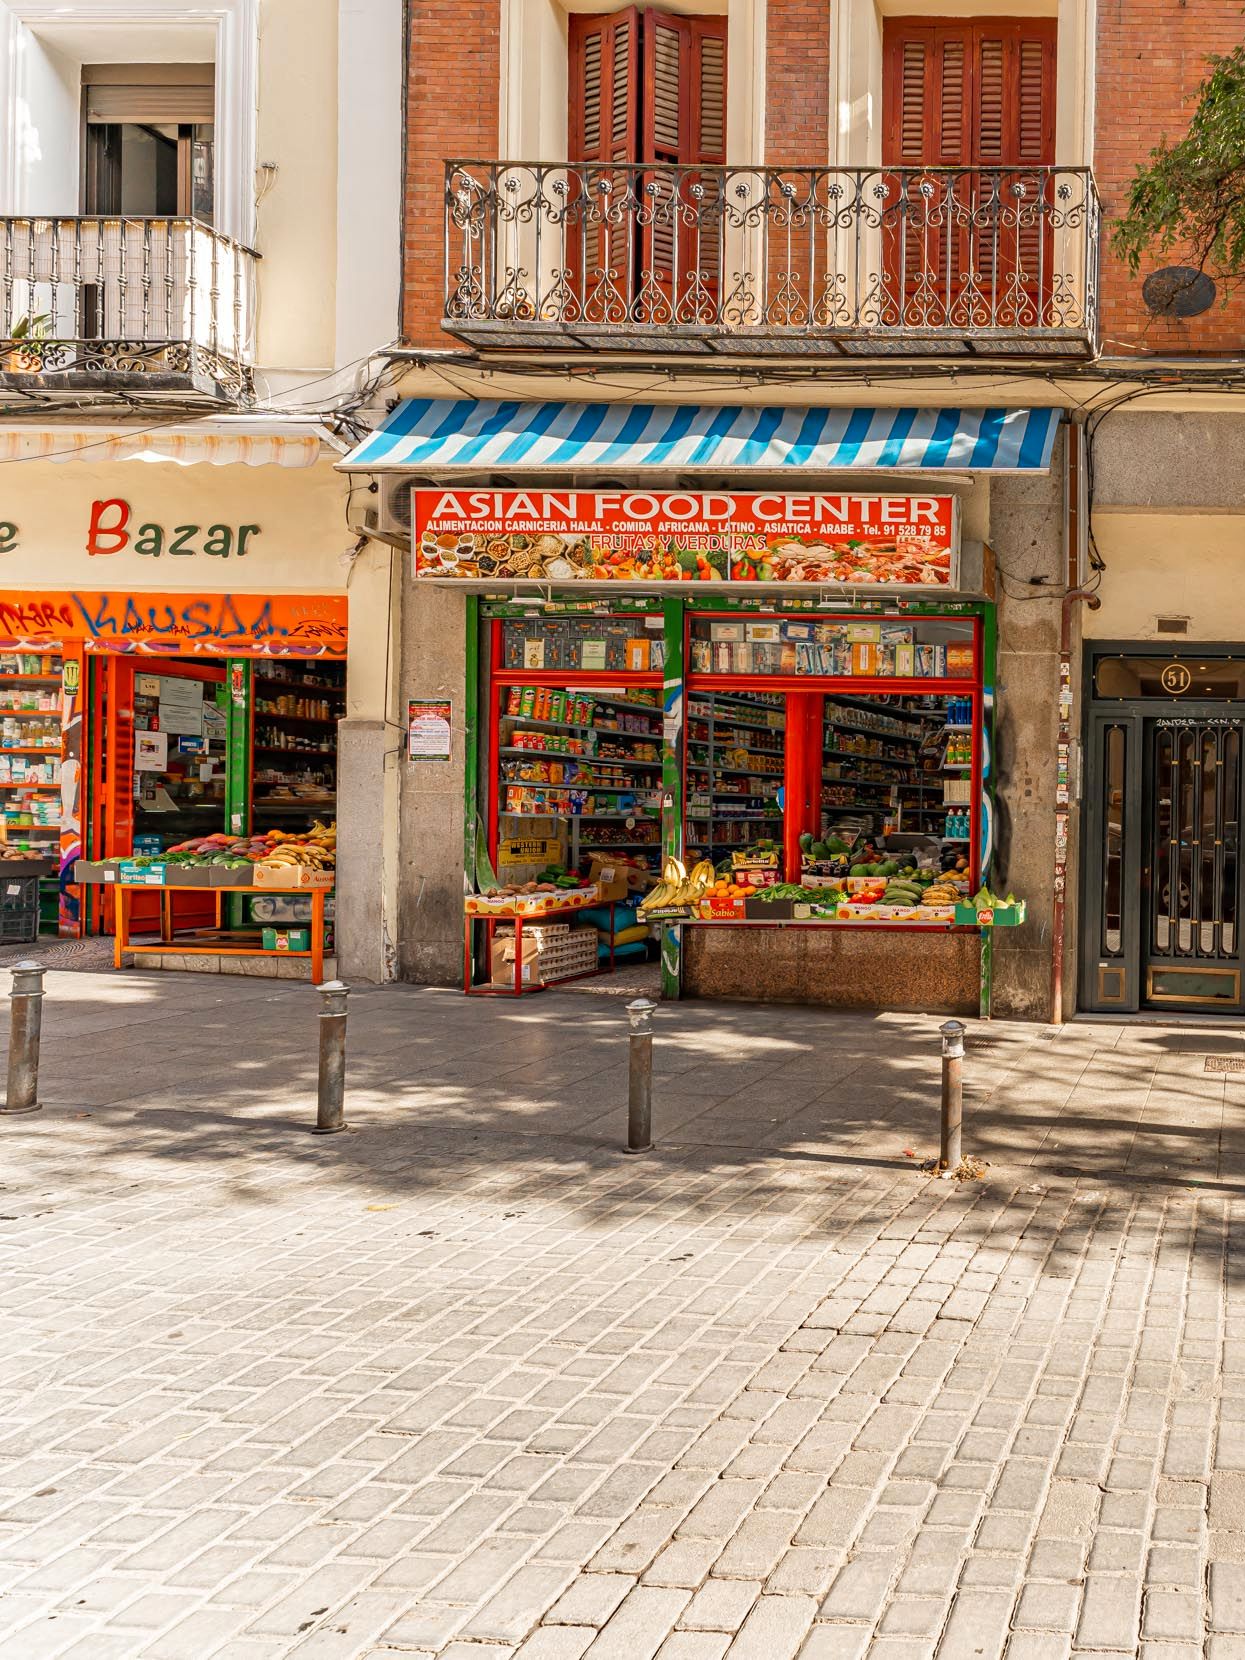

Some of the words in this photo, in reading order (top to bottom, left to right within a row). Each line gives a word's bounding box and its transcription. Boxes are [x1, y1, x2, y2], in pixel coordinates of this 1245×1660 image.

[431, 492, 577, 519] ASIAN
[594, 494, 737, 521] FOOD
[751, 495, 940, 523] CENTER
[86, 498, 261, 557] Bazar
[426, 520, 502, 532] ALIMENTACION
[505, 520, 567, 532] CARNICERIA
[570, 521, 604, 532] HALAL
[612, 521, 652, 533] COMIDA
[657, 522, 709, 533] AFRICANA
[717, 522, 755, 534] LATINO
[764, 522, 812, 535] ASIATICA
[820, 524, 855, 535] ARABE
[863, 524, 881, 535] Tel.
[884, 525, 895, 536] 91
[898, 525, 917, 536] 528
[920, 525, 931, 536] 79
[934, 525, 946, 537] 85
[591, 534, 655, 551] FRUTAS
[659, 535, 671, 551] Y
[674, 535, 767, 552] VERDURAS
[1167, 671, 1185, 687] 51
[710, 907, 735, 917] Sabio
